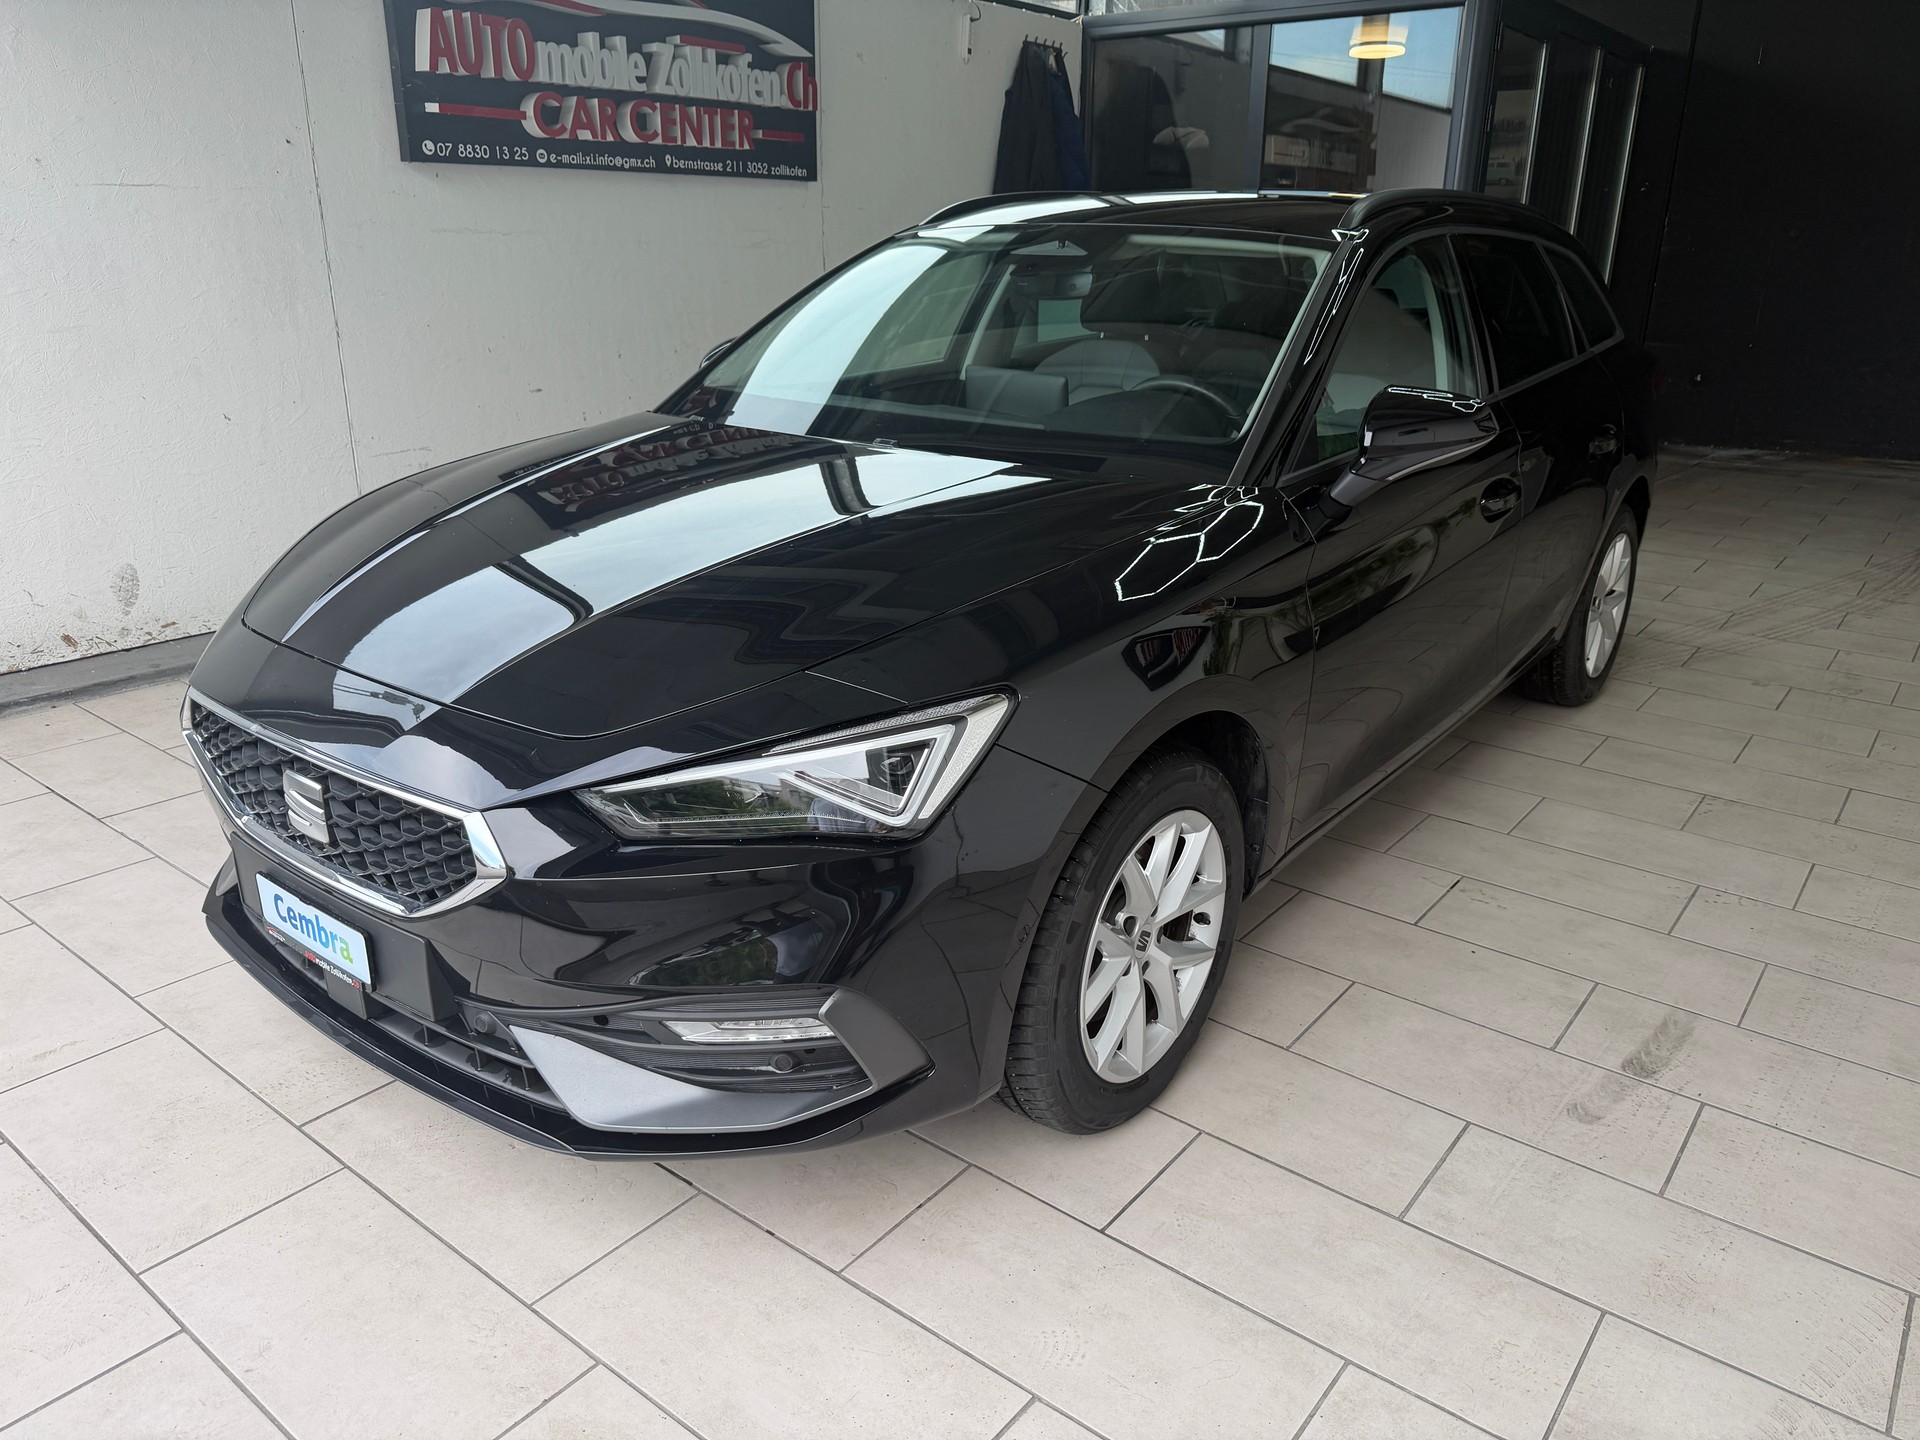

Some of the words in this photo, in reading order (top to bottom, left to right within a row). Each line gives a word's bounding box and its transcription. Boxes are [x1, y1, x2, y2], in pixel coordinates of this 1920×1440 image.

[415, 7, 647, 92] AUTOmobile
[520, 91, 622, 142] CAR
[616, 99, 755, 150] CENTER
[437, 142, 453, 157] 07
[458, 143, 490, 159] 8830
[496, 145, 510, 160] 13
[514, 146, 529, 161] 25
[550, 151, 656, 169] e-mail:xi.info@gmx.ch
[672, 156, 724, 172] bernstrasse
[726, 159, 744, 174] 211
[747, 161, 769, 175] 3052
[770, 164, 808, 178] zollikofen
[273, 893, 354, 965] Cembra
